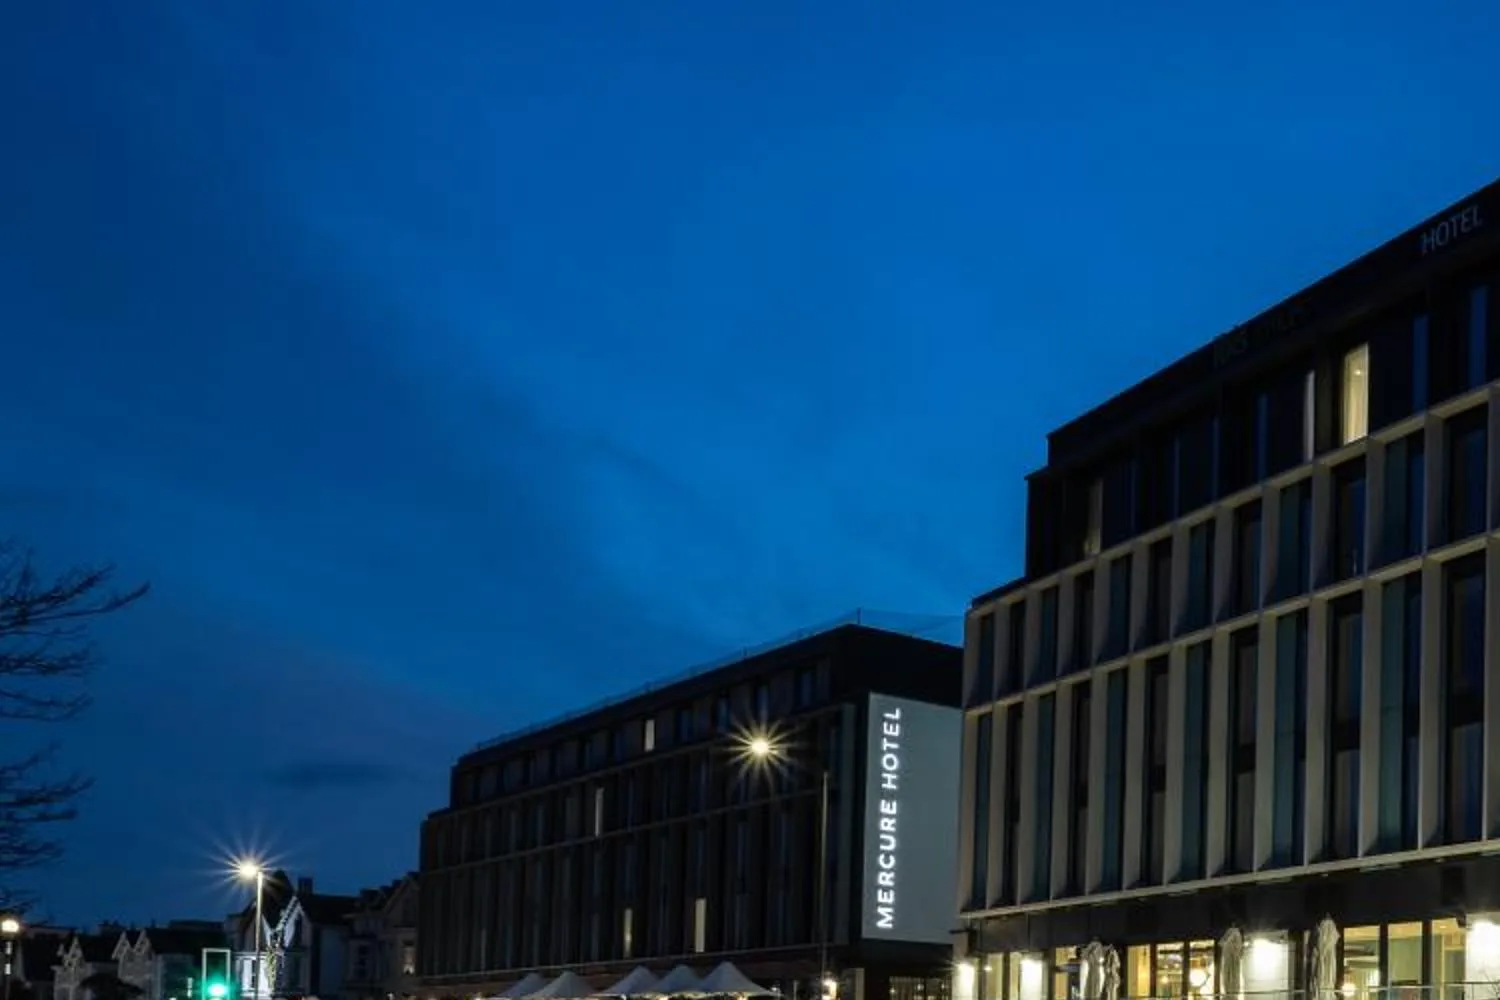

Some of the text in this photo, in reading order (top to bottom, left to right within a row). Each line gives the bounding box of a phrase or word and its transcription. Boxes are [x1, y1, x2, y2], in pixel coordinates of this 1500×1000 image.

[1421, 204, 1483, 256] HOTEL
[876, 707, 901, 930] MERCURE HOTEL
